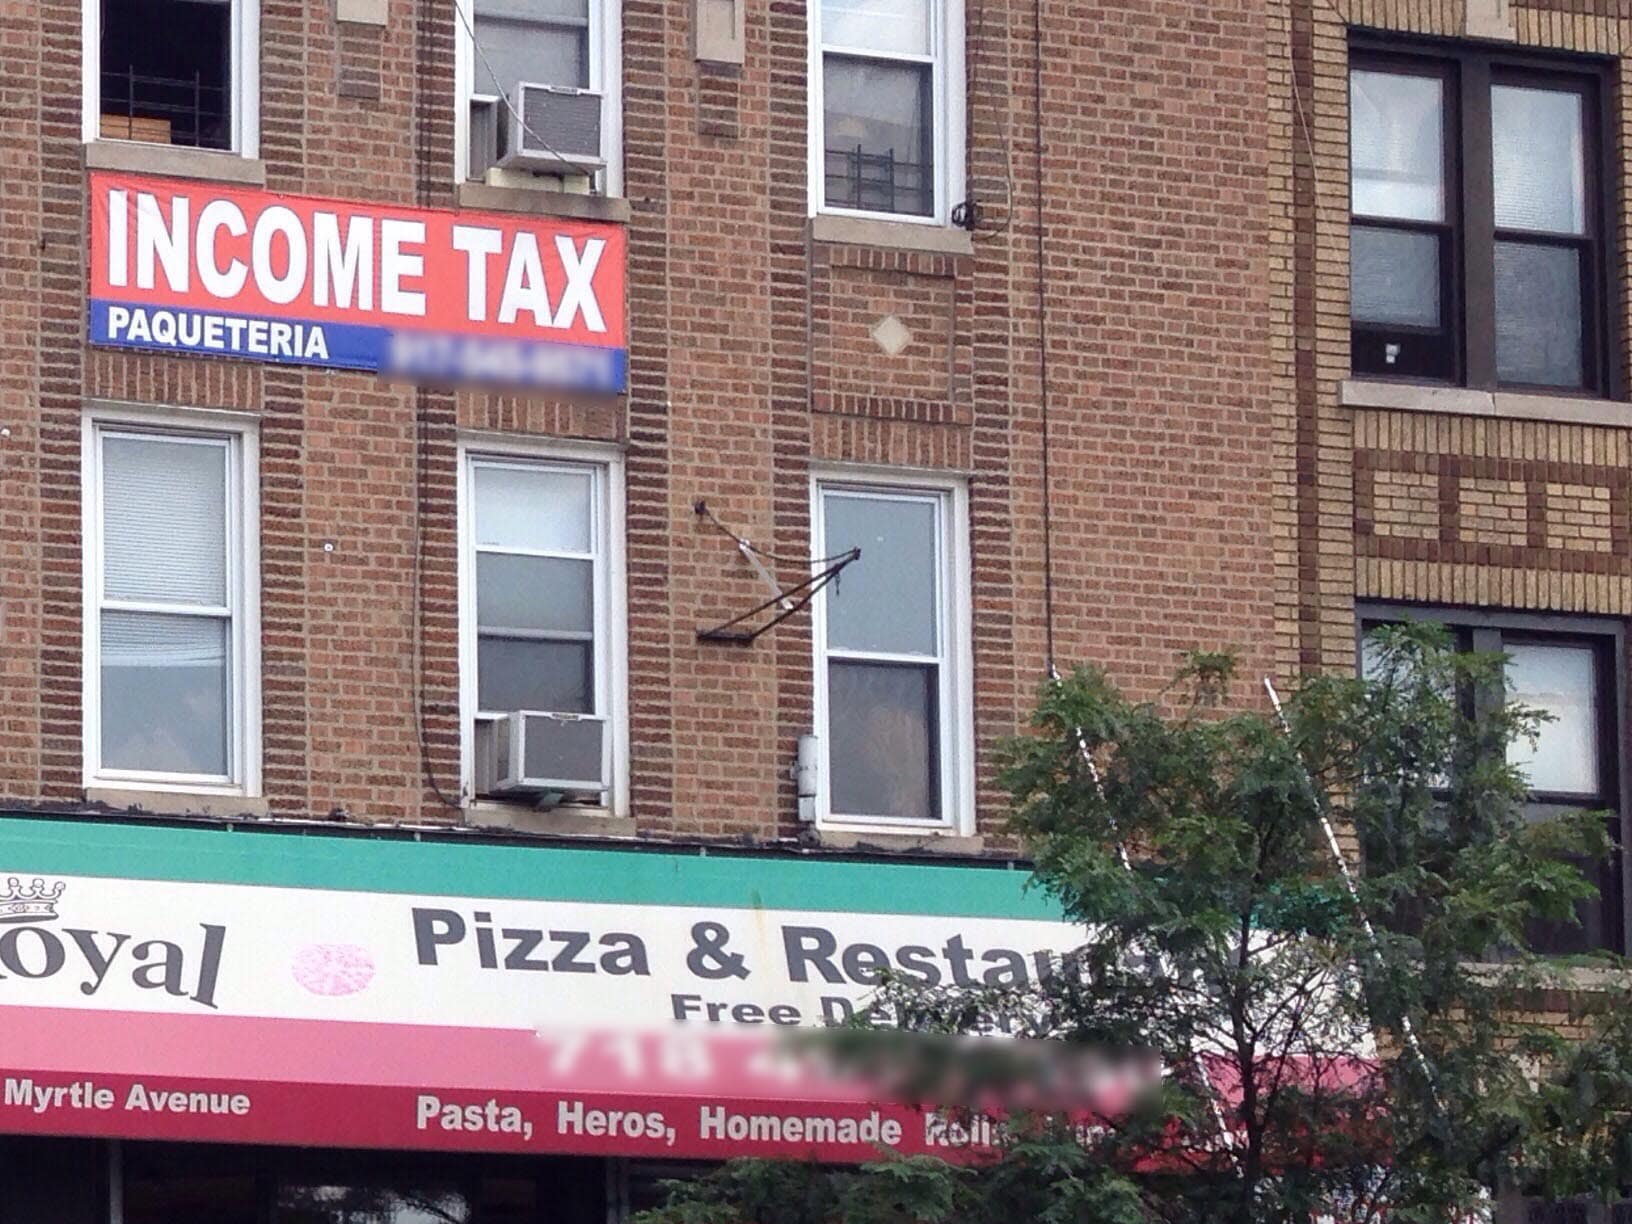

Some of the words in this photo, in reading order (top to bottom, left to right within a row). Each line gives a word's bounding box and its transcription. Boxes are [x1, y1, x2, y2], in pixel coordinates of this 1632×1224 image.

[108, 189, 426, 316] INCOME
[452, 224, 607, 333] TAX
[108, 306, 329, 359] PAQUETERIA
[411, 907, 651, 976] Pizza
[685, 921, 752, 981] &
[670, 993, 801, 1027] Free
[4, 1078, 115, 1115] Myrtle
[124, 1084, 250, 1116] Avenue
[416, 1094, 533, 1141] Pasta,
[557, 1100, 676, 1146] Heros,
[700, 1105, 903, 1146] Homemade
